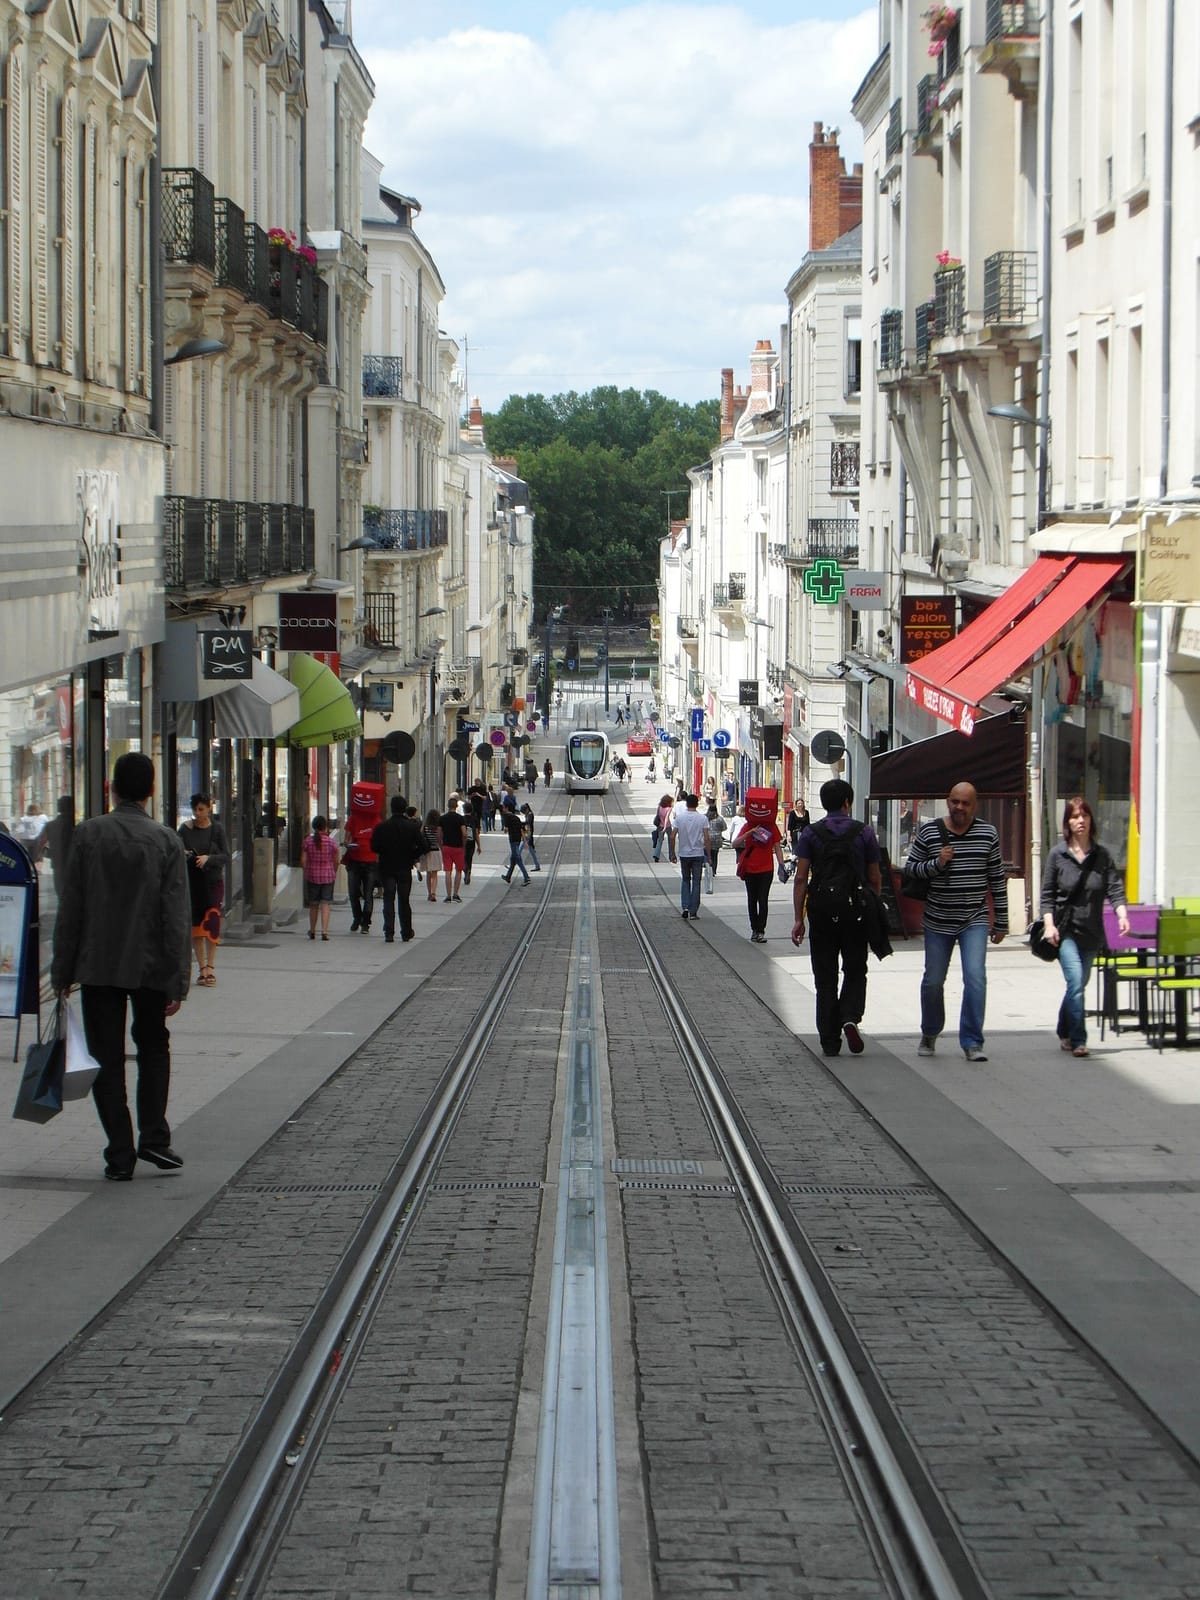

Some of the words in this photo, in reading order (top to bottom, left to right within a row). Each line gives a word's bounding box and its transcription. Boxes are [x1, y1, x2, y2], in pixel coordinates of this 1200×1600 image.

[1149, 550, 1191, 560] Coiffure
[849, 587, 881, 597] FRAM
[915, 600, 942, 611] bar
[279, 618, 336, 627] COCOON
[910, 613, 947, 622] salon
[906, 630, 950, 640] resto
[211, 636, 245, 654] PM
[924, 639, 933, 649] à
